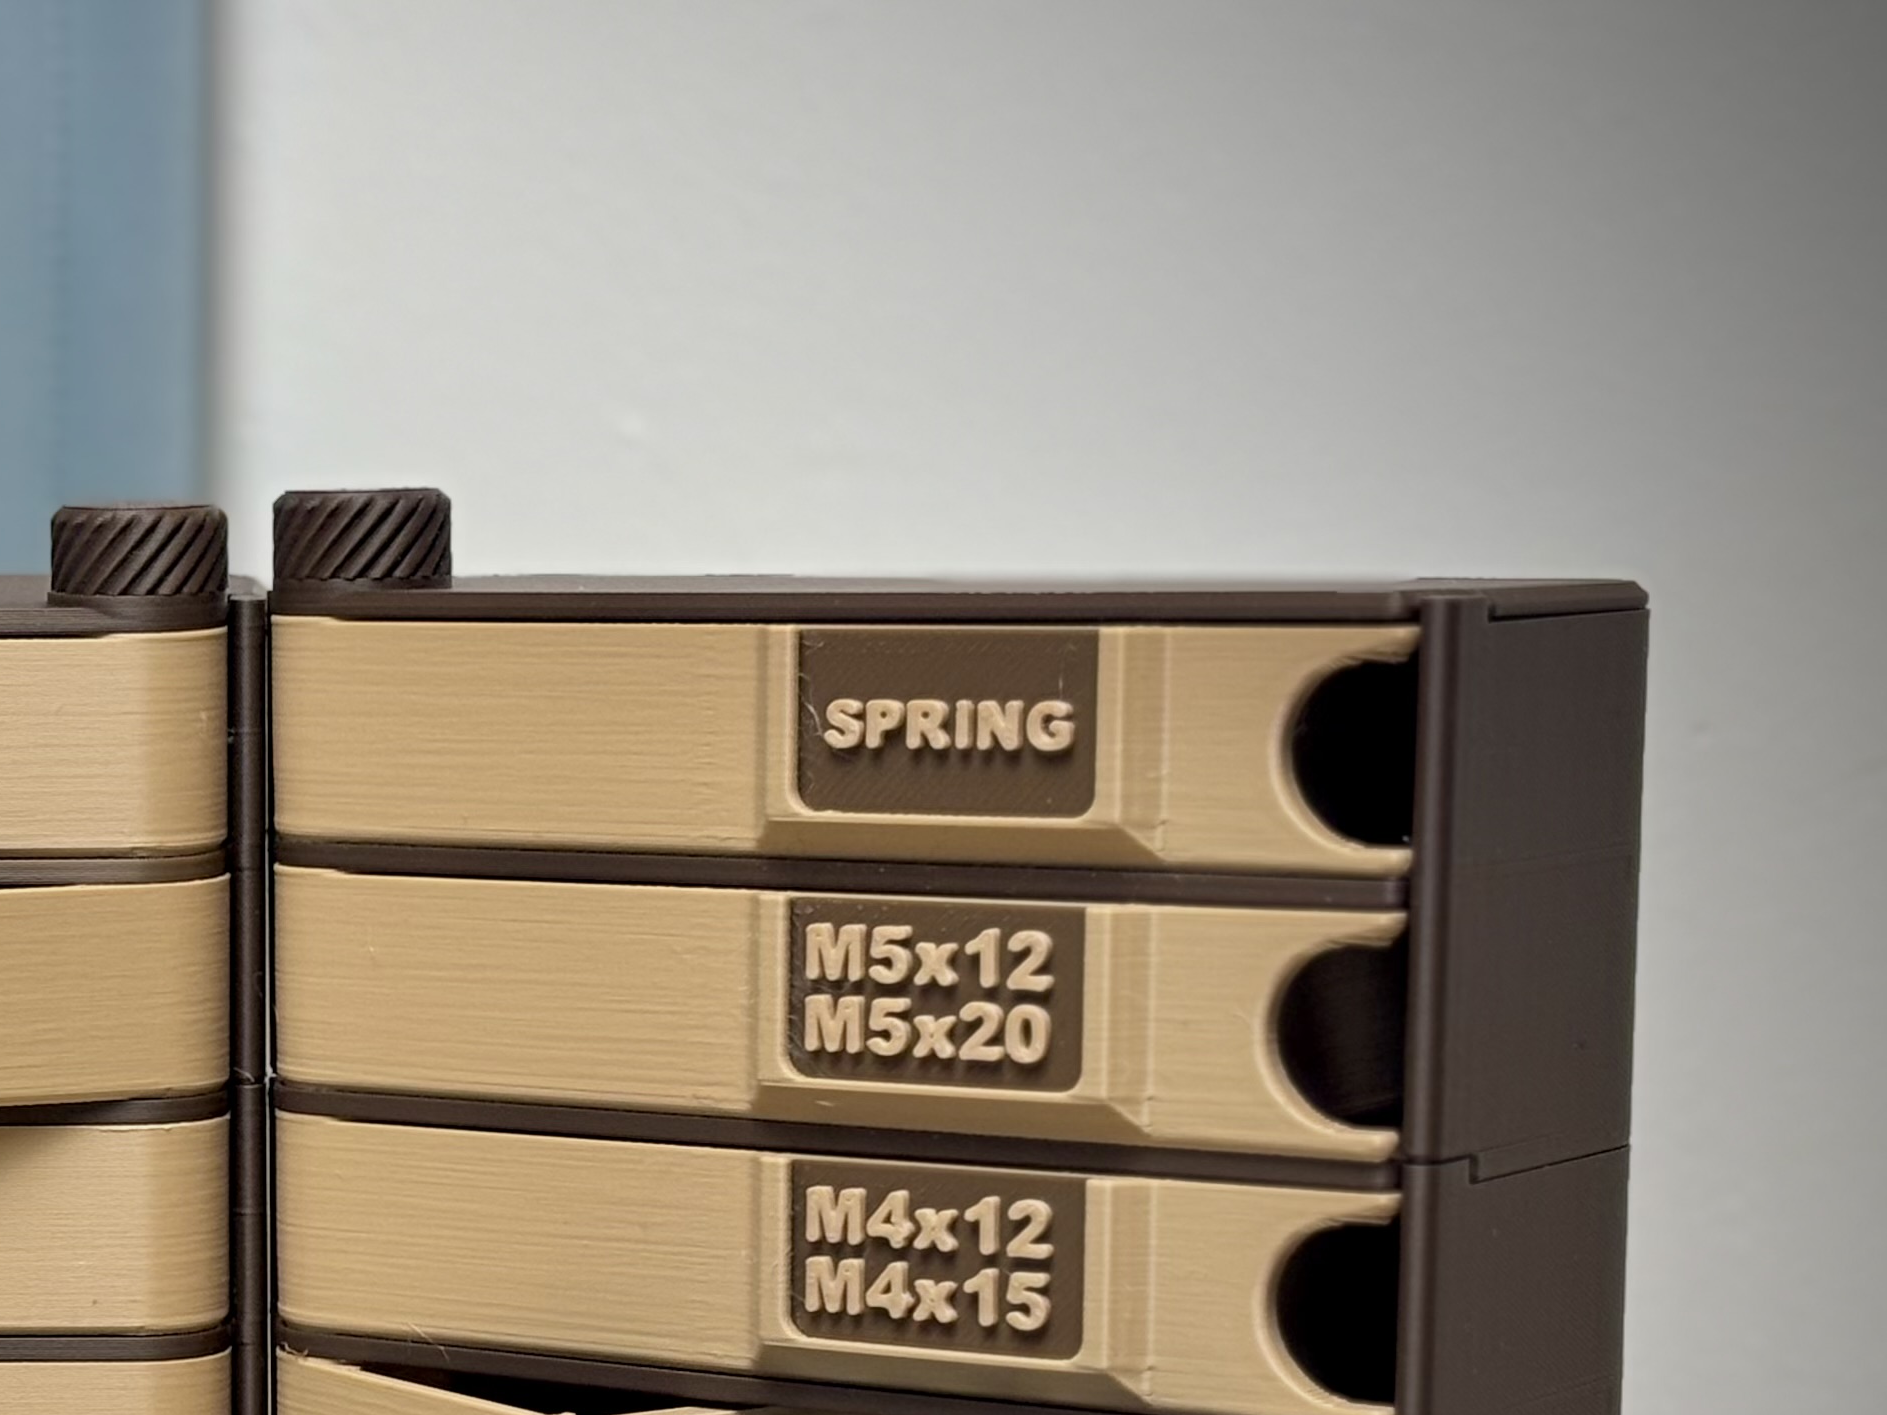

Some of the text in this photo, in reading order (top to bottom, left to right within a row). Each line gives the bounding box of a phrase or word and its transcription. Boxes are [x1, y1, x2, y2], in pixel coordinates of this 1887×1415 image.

[823, 698, 1077, 752] SPRING
[805, 922, 1055, 993] M5x12
[804, 994, 1051, 1065] M5x20
[805, 1185, 1055, 1260] M4x12
[804, 1255, 1051, 1332] M4x15
